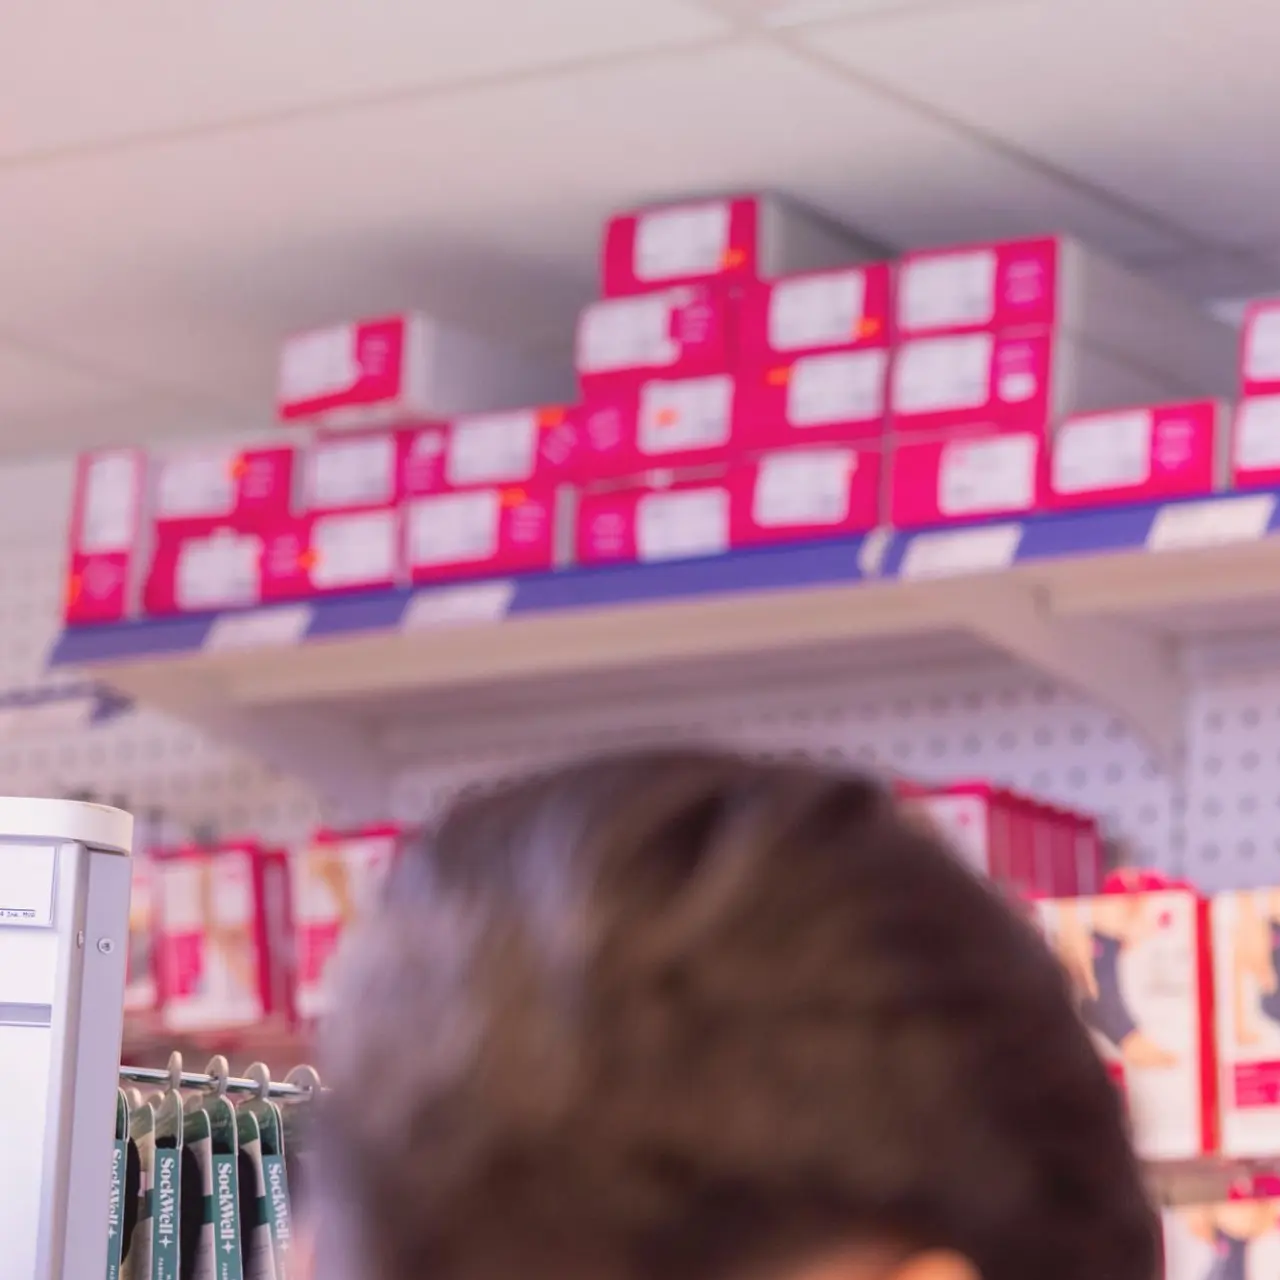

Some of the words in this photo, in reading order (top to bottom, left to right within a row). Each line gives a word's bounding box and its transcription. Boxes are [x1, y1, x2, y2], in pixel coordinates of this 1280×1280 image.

[159, 1157, 174, 1234] SockWell
[218, 1163, 235, 1240] SockWell
[268, 1163, 290, 1240] SockWell
